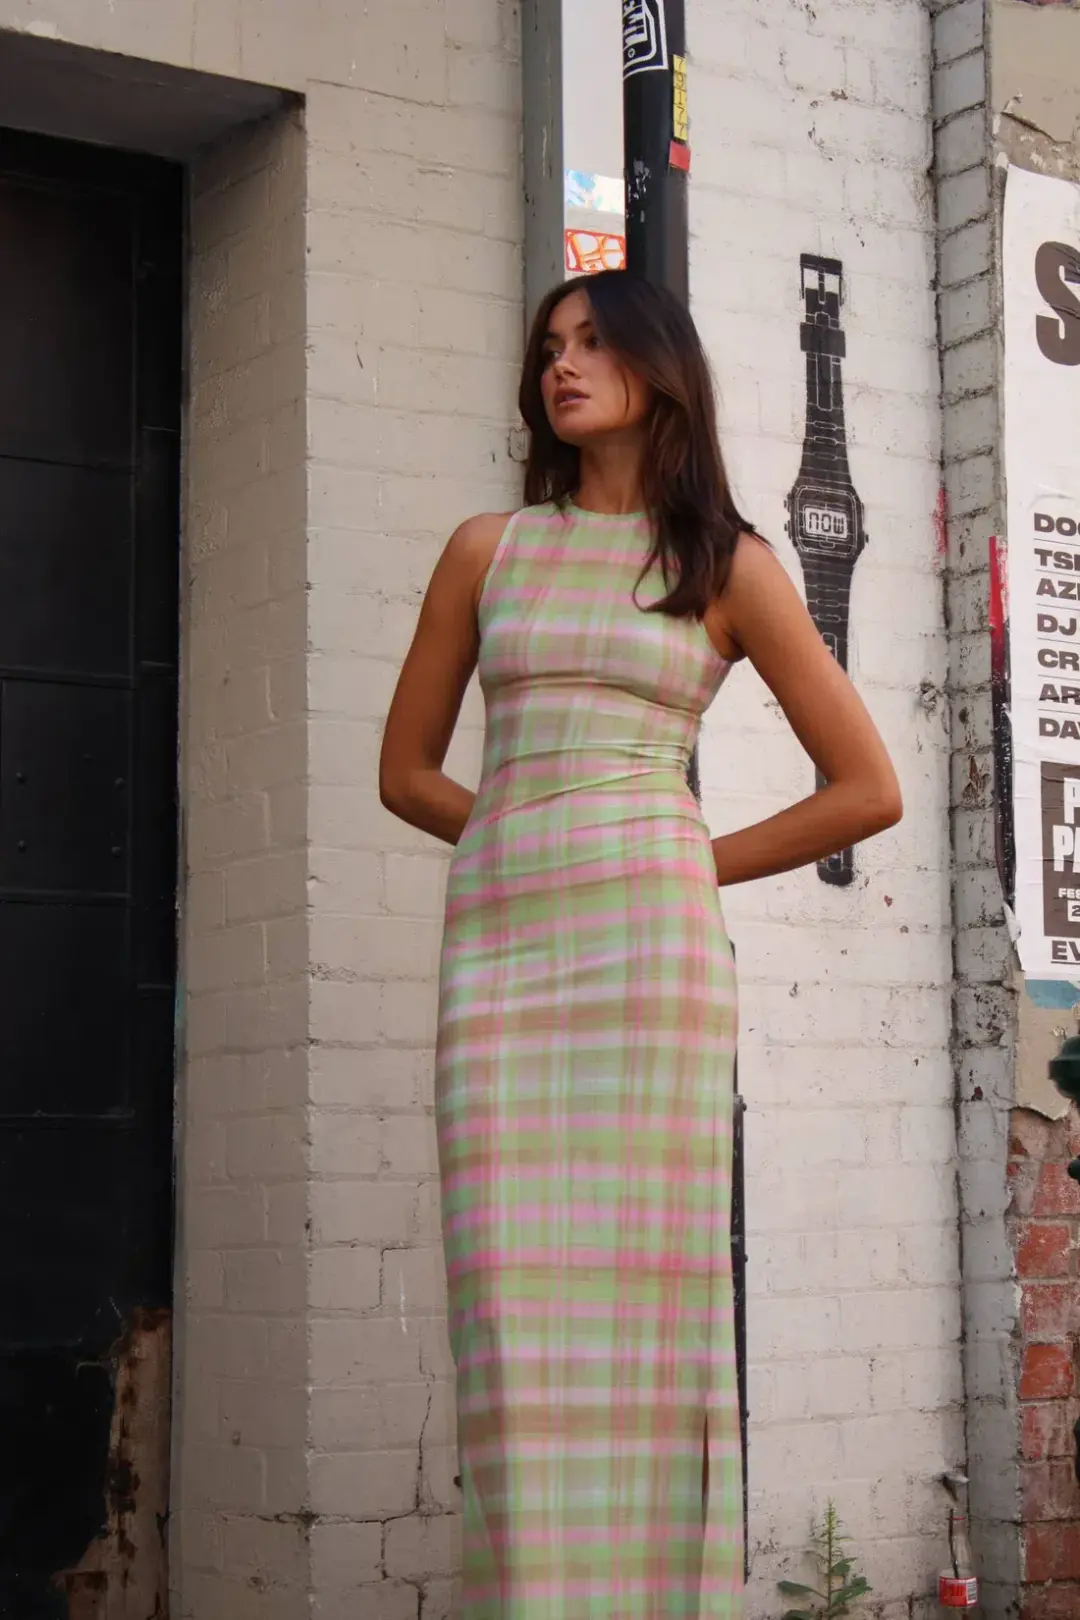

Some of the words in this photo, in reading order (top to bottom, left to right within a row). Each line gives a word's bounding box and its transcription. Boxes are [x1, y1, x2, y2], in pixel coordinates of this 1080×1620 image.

[1034, 512, 1080, 537] DO
[1036, 578, 1080, 601] AZ
[1037, 613, 1077, 636] DJ
[1039, 717, 1080, 740] DA
